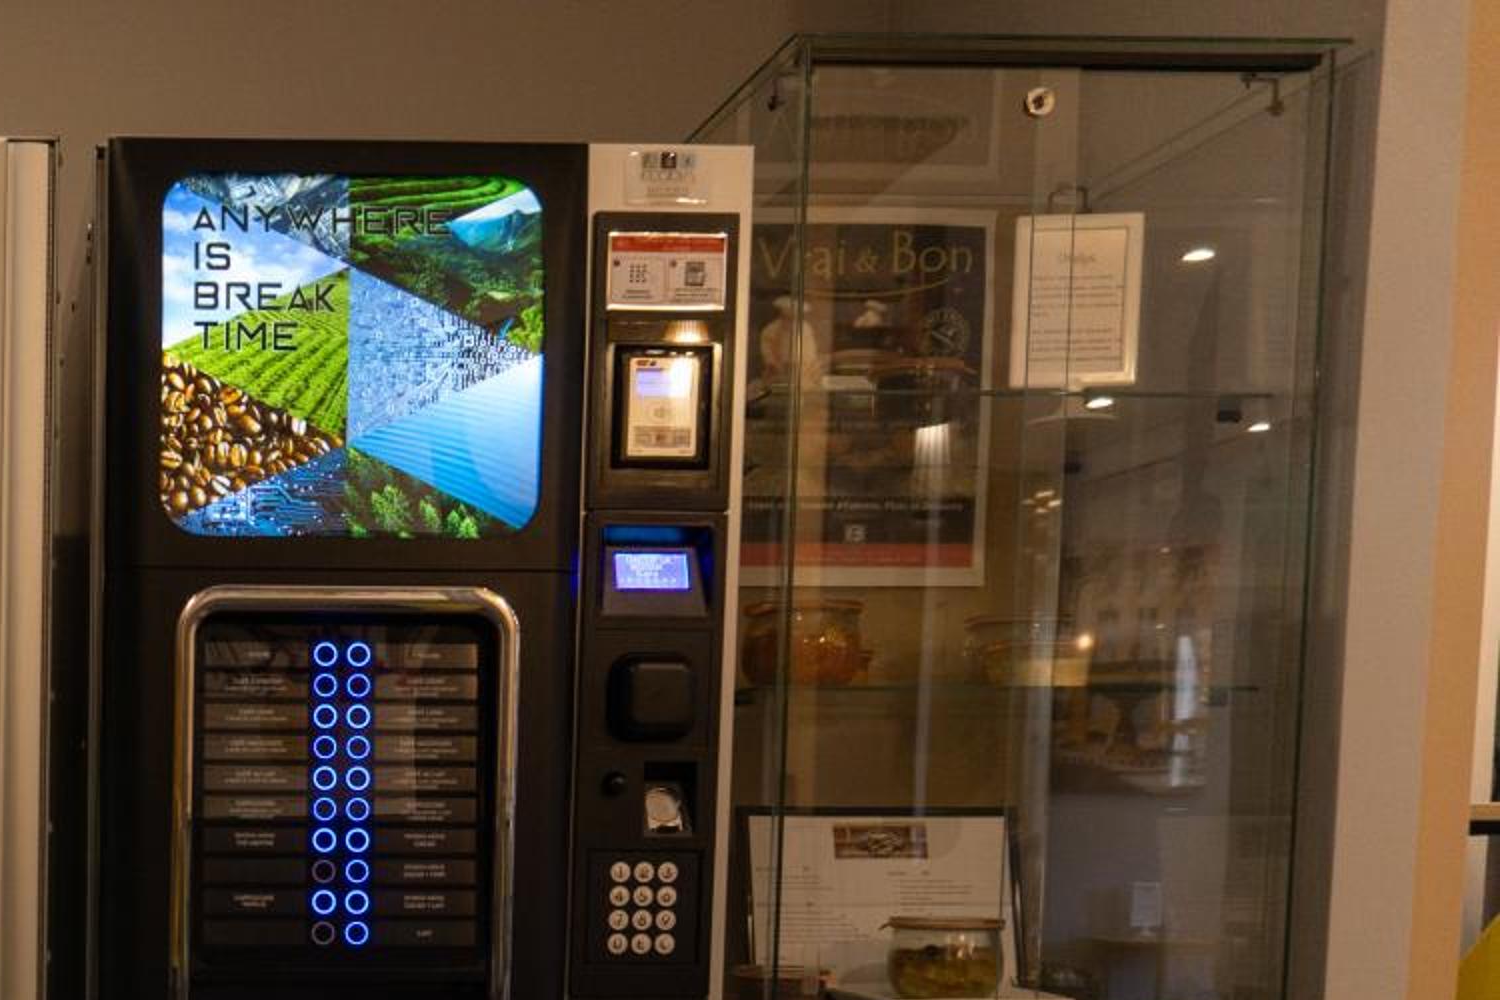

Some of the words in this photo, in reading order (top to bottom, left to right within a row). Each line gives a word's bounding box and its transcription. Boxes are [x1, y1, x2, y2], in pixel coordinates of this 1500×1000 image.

[193, 206, 454, 236] ANYWHERE
[193, 241, 232, 271] IS
[893, 230, 974, 273] Bon
[193, 281, 337, 313] BREAK
[193, 321, 300, 351] TIME
